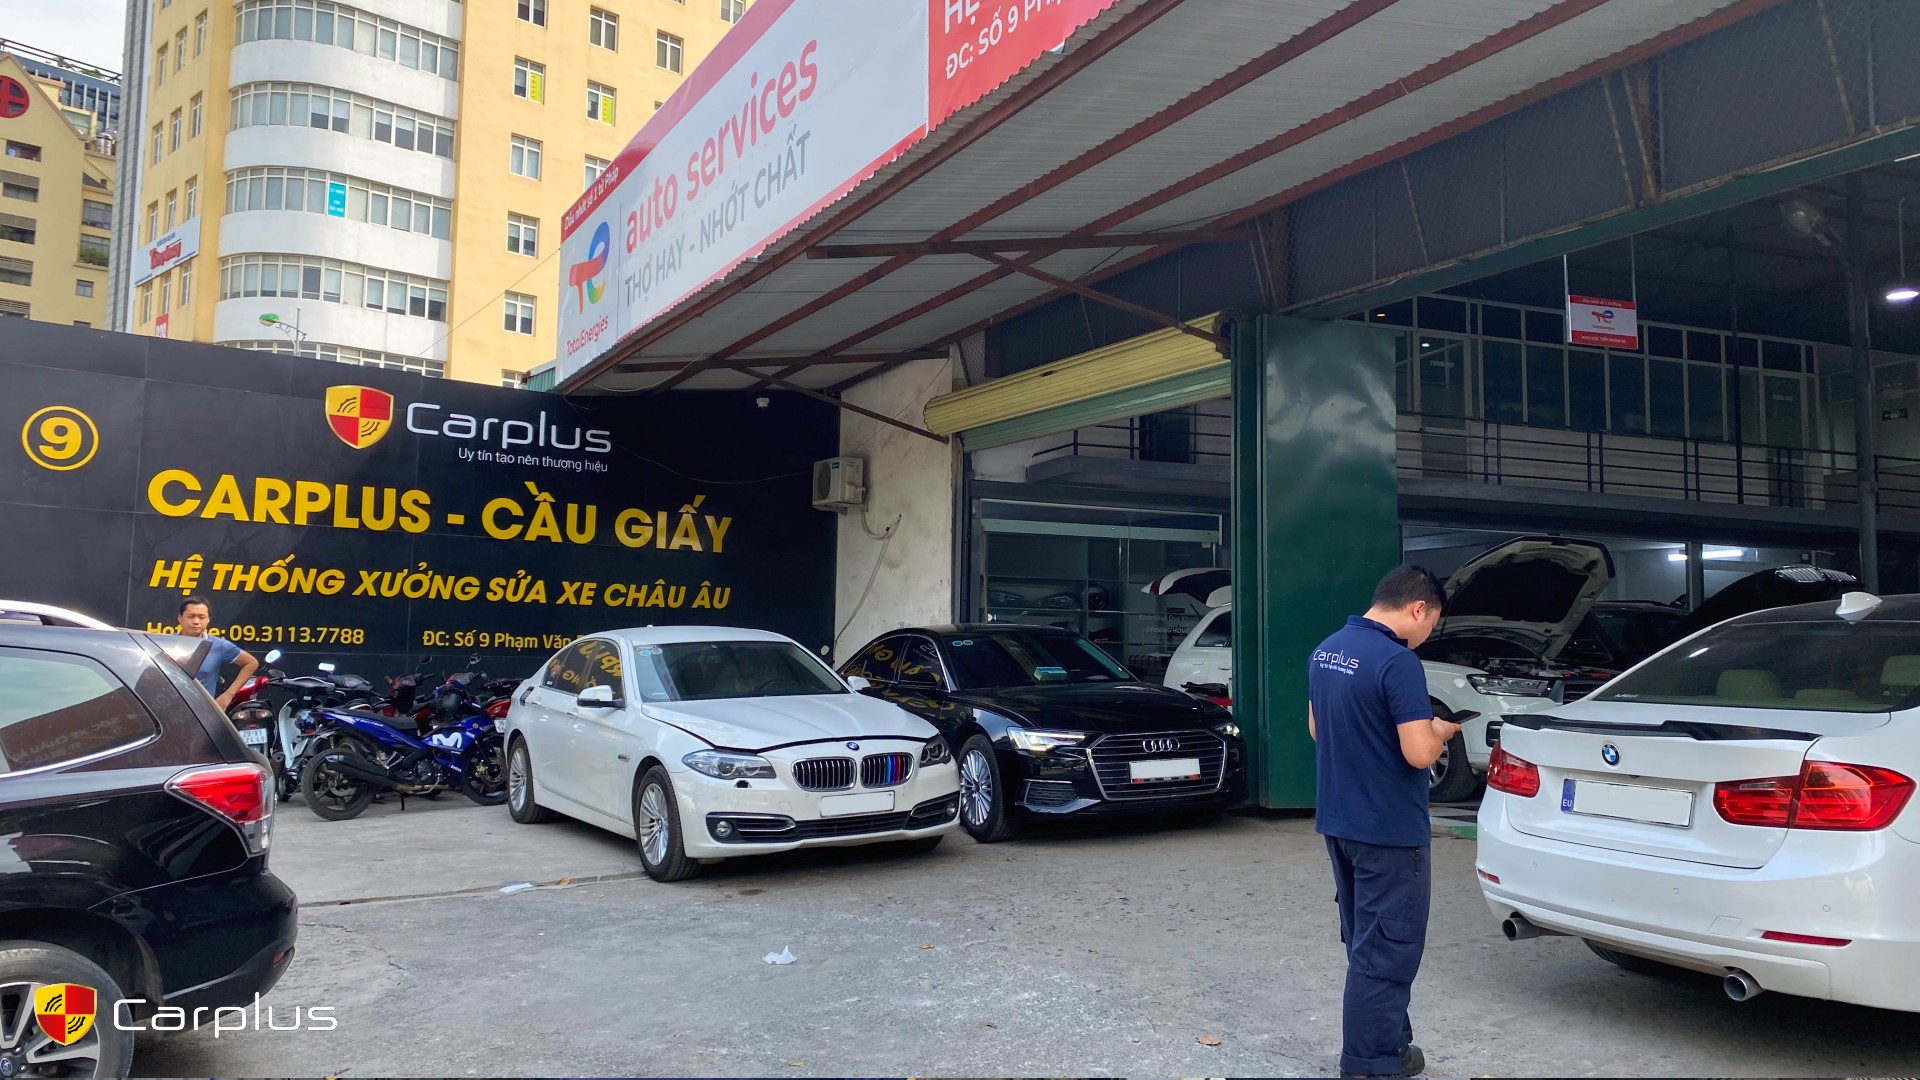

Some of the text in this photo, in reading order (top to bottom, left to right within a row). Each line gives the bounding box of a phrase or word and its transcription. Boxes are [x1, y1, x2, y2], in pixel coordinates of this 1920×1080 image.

[945, 45, 974, 80] ĐC:
[1007, 5, 1019, 34] 9
[626, 39, 818, 254] auto services
[624, 258, 653, 307] THỢ
[656, 233, 685, 286] HAY
[700, 180, 749, 254] NHỚT
[754, 124, 811, 209] CHẤT
[566, 315, 609, 358] TotalEnergies
[39, 416, 82, 460] 9
[406, 402, 612, 453] Carplus
[458, 447, 474, 462] Uy
[477, 449, 492, 462] tín
[495, 451, 515, 465] tạo
[518, 454, 539, 466] nên
[542, 456, 582, 472] thương
[147, 469, 431, 533] CARPLUS
[481, 481, 597, 545] CẦU
[614, 494, 732, 553] GIẤY
[149, 553, 731, 609] HỆ THỐNG XƯỞNG SỬA XE CHÂU ÂU
[229, 624, 365, 645] 09.3113.7788
[422, 630, 450, 646] ĐC:
[454, 629, 478, 647] Số
[479, 632, 490, 648] 9
[494, 633, 539, 652] Phạm
[1313, 649, 1360, 669] Carplus
[1562, 799, 1573, 807] EU
